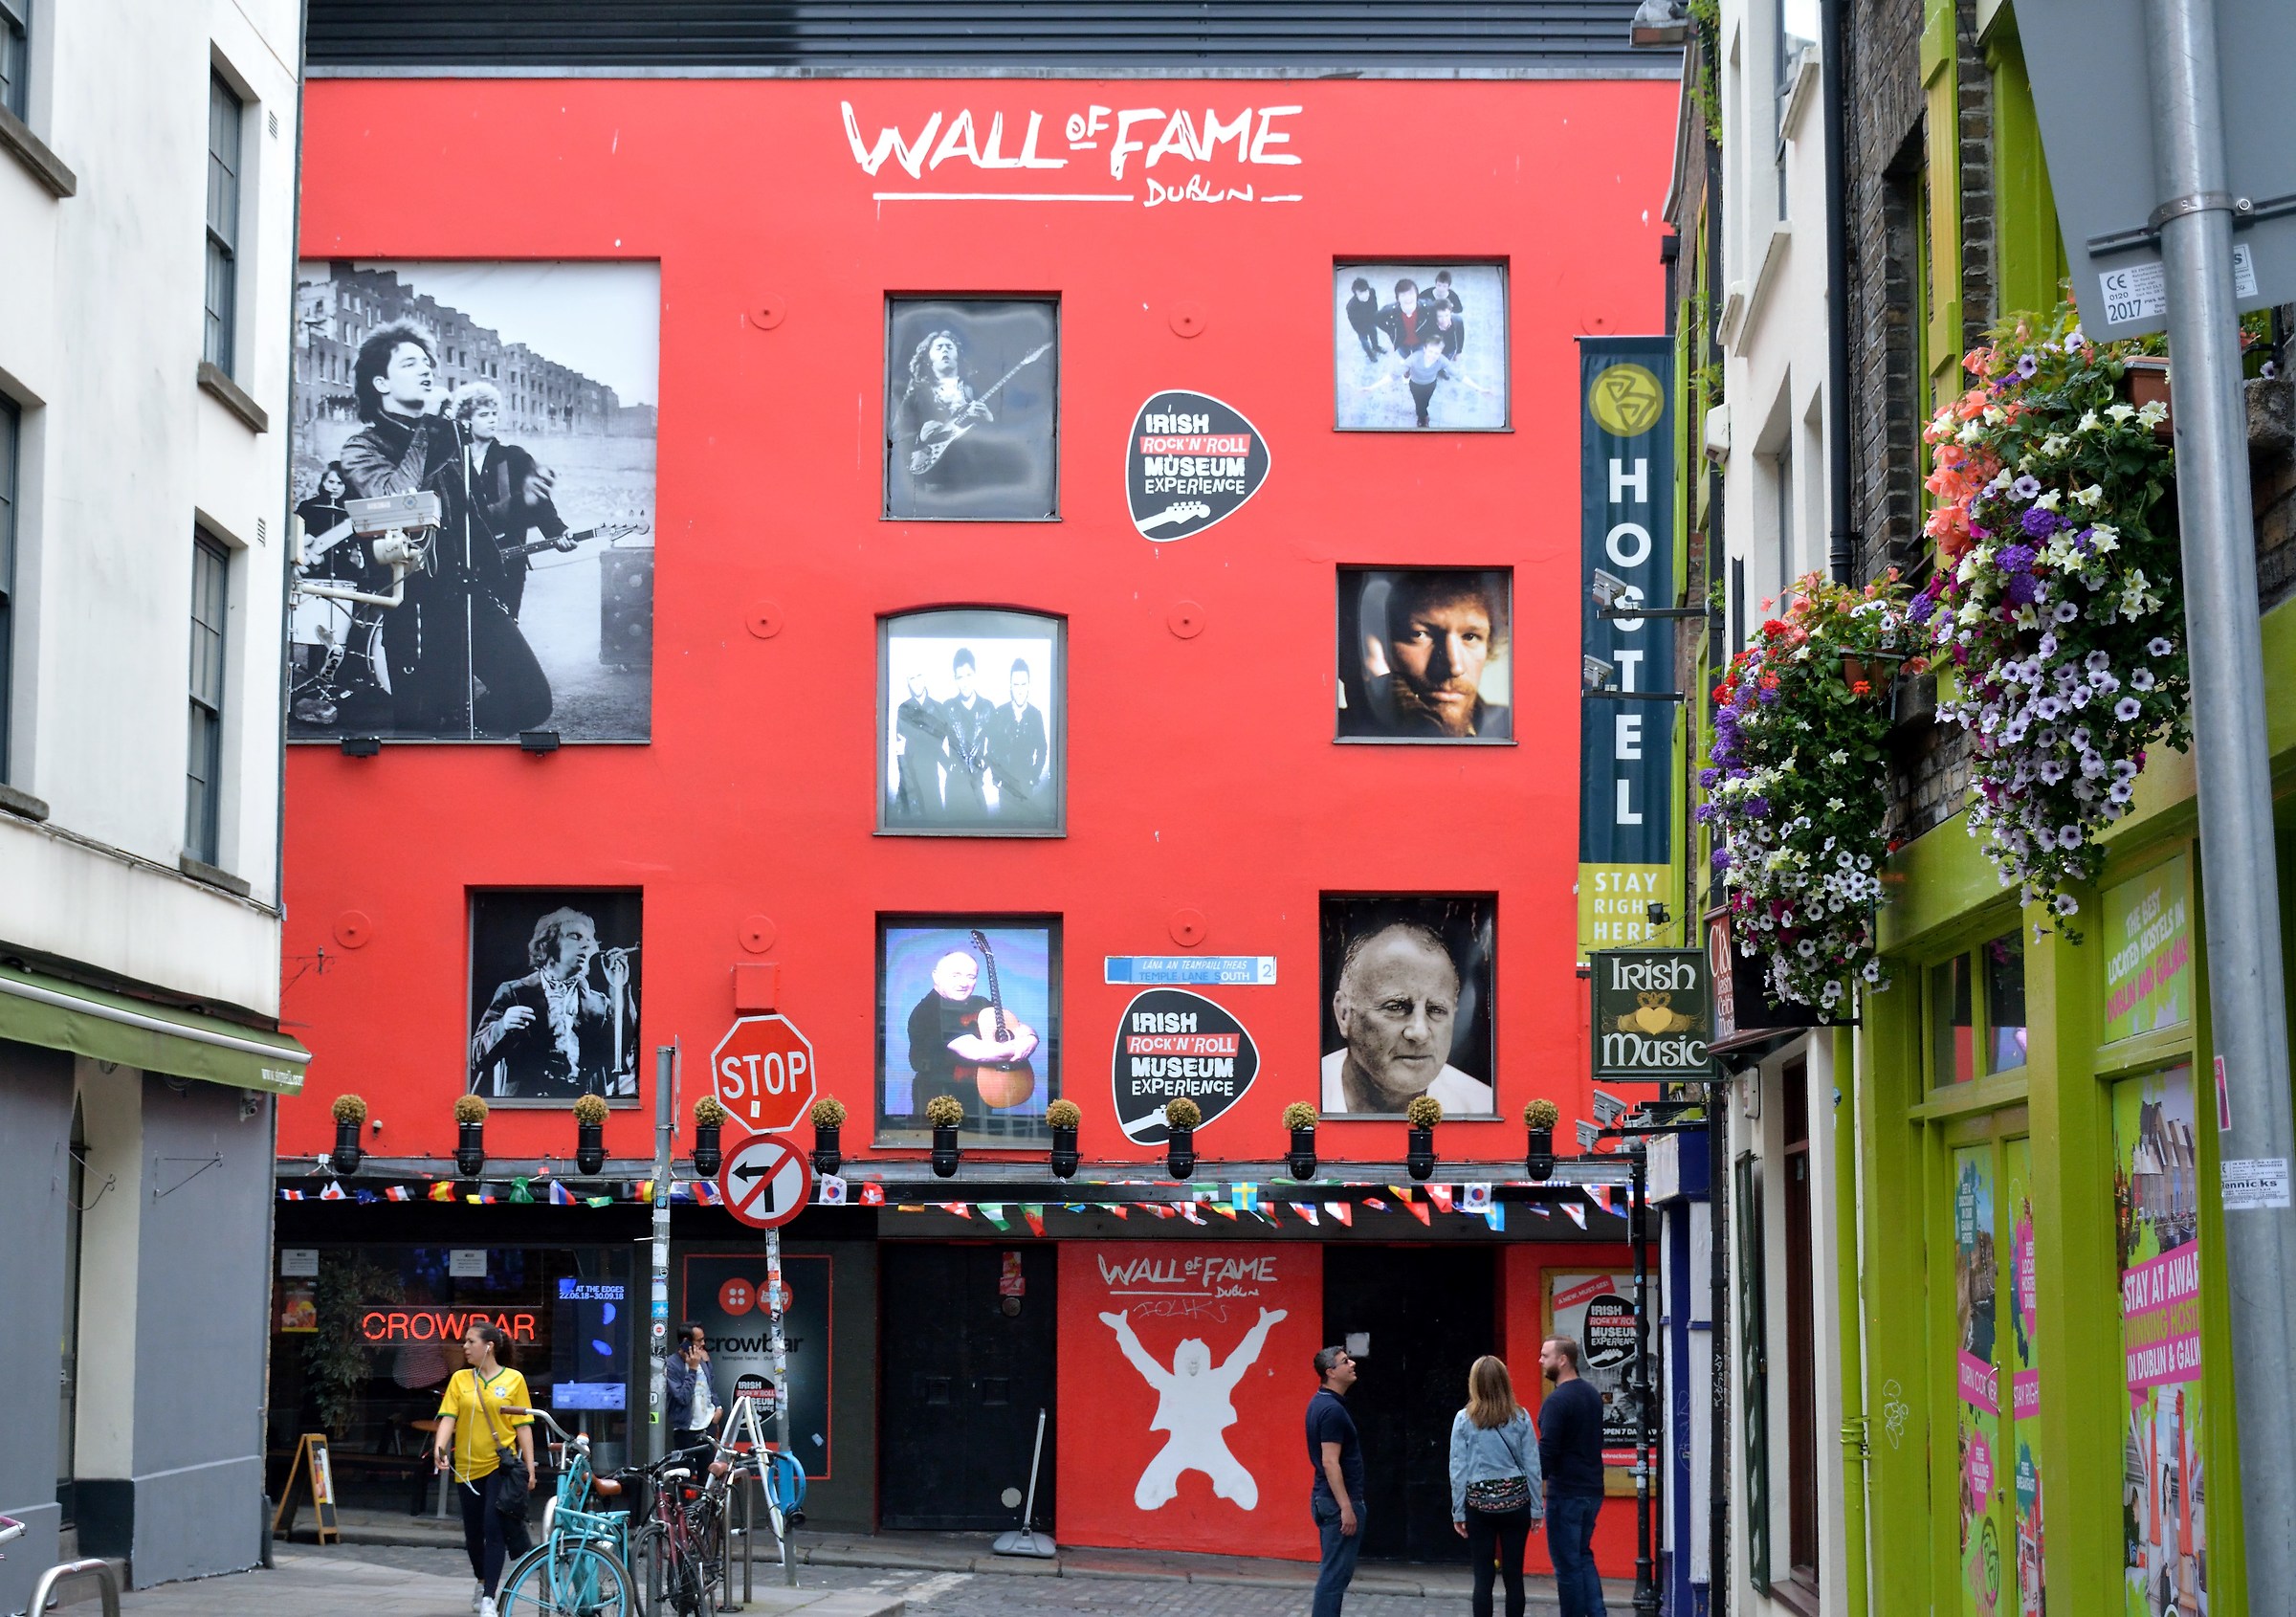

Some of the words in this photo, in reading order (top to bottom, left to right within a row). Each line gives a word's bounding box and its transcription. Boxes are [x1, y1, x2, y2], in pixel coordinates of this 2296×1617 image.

[841, 100, 1069, 180] WALL
[1065, 104, 1112, 145] OF
[1111, 105, 1304, 181] FAME
[2108, 291, 2129, 301] 0120
[2108, 299, 2141, 322] 2017
[1145, 413, 1210, 434] IRISH
[1144, 456, 1246, 477] MUSEUM
[1144, 477, 1246, 496] EXPERIENCE
[1605, 457, 1652, 825] HOSTEL
[1594, 872, 1658, 893] STAY
[1593, 921, 1656, 941] HERE
[2108, 940, 2140, 986] LOCATED
[2140, 907, 2174, 959] HOSTELS
[1138, 971, 1178, 981] TEMPLE
[1181, 971, 1208, 981] LANE
[1214, 970, 1250, 981] SOUTH
[1165, 960, 1178, 970] AN
[1222, 960, 1247, 970] THEAS
[1262, 964, 1272, 978] 2
[1611, 956, 1696, 991] Irish
[2107, 977, 2136, 1025] DUBLIN
[1132, 1012, 1198, 1033] IRISH
[1601, 1032, 1709, 1067] Music
[720, 1051, 807, 1099] STOP
[1131, 1056, 1234, 1078] MUSEUM
[1132, 1078, 1234, 1096] EXPERIENCE
[1097, 1253, 1186, 1286] WALL
[1184, 1256, 1203, 1273] OF
[1203, 1256, 1278, 1287] FAME
[2124, 1270, 2149, 1314] STAY
[2152, 1263, 2165, 1305] AT
[1591, 1305, 1623, 1316] IRISH
[2126, 1307, 2169, 1349] WINNING
[2127, 1353, 2136, 1383] IN
[2137, 1343, 2167, 1381] DUBLIN
[2168, 1343, 2175, 1373] &
[738, 1381, 762, 1389] IRISH
[1961, 1362, 1975, 1387] TURN
